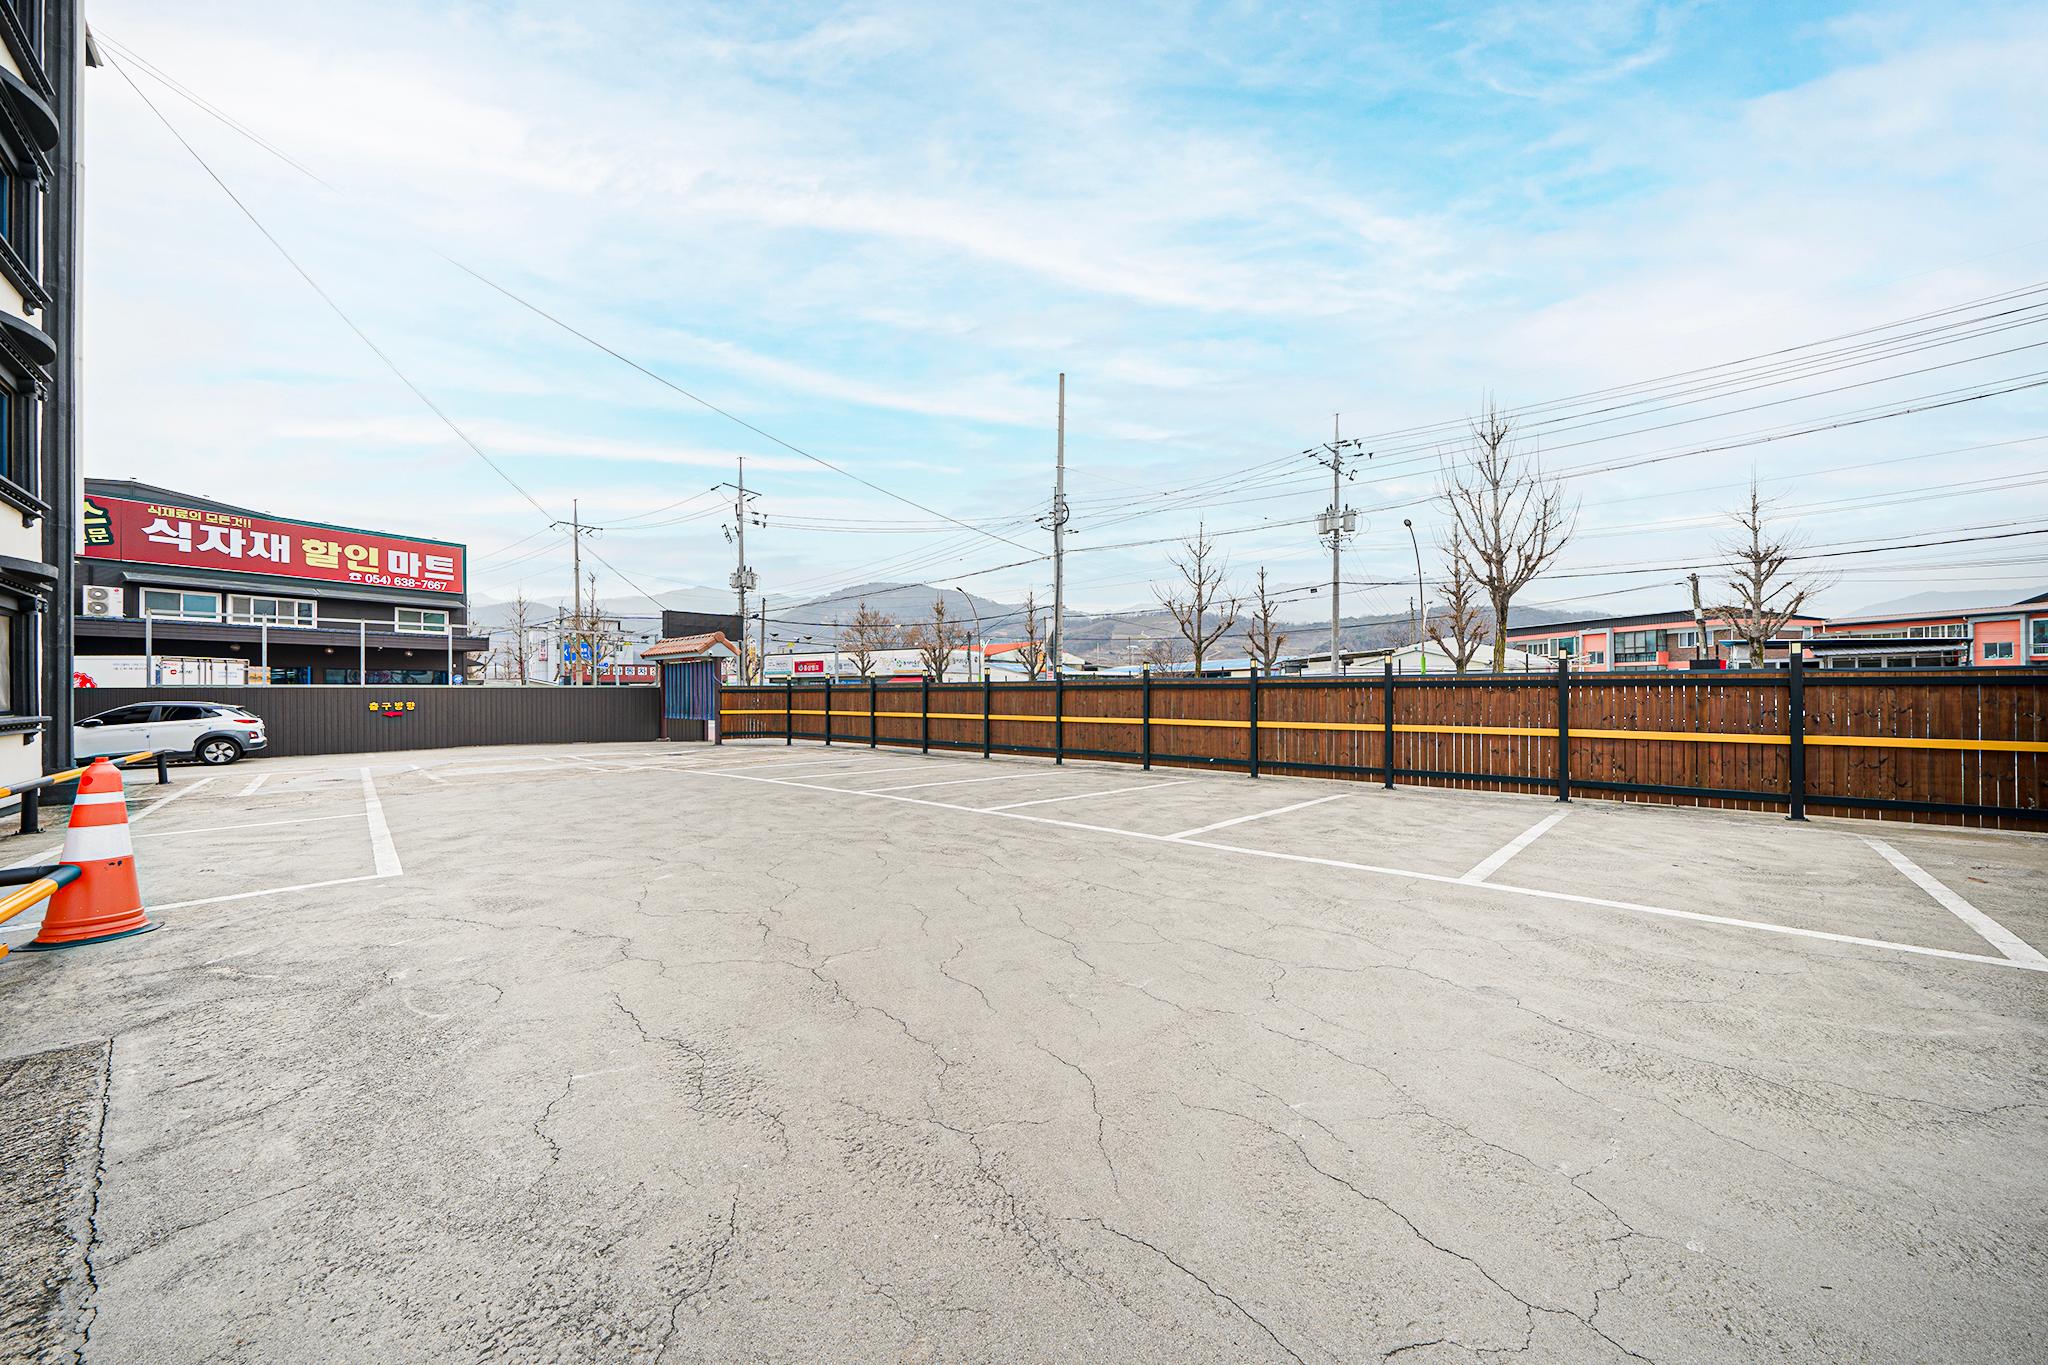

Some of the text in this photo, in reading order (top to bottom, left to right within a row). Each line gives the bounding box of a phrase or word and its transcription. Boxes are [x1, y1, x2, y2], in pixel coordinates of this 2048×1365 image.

[147, 505, 252, 528] 식재료의 모든것!!
[141, 518, 455, 581] 식자재 할인 마트
[365, 573, 448, 591] 054) 638-7667
